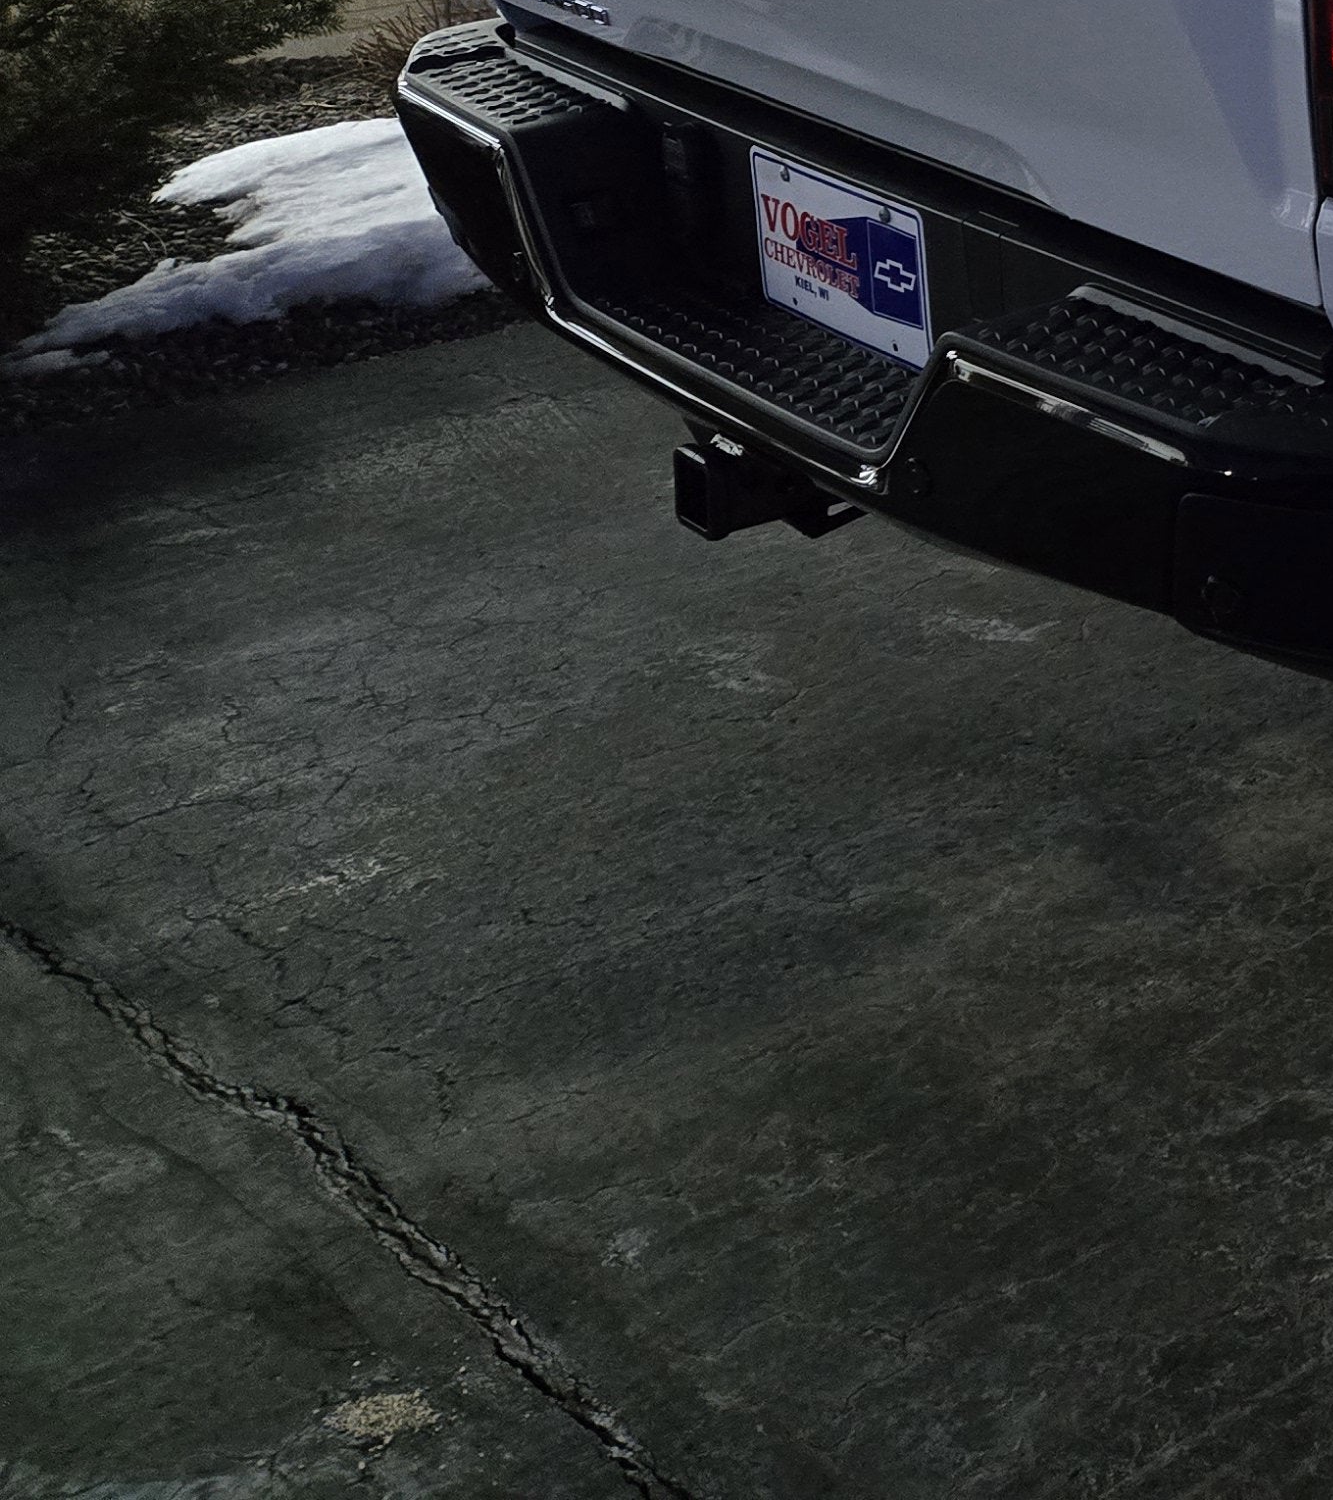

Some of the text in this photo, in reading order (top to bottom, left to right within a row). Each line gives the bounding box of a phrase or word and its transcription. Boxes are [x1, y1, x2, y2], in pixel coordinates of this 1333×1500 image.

[760, 193, 857, 271] VOGEL
[764, 237, 859, 299] CHEVROLET
[795, 275, 829, 301] KIEL, WI
